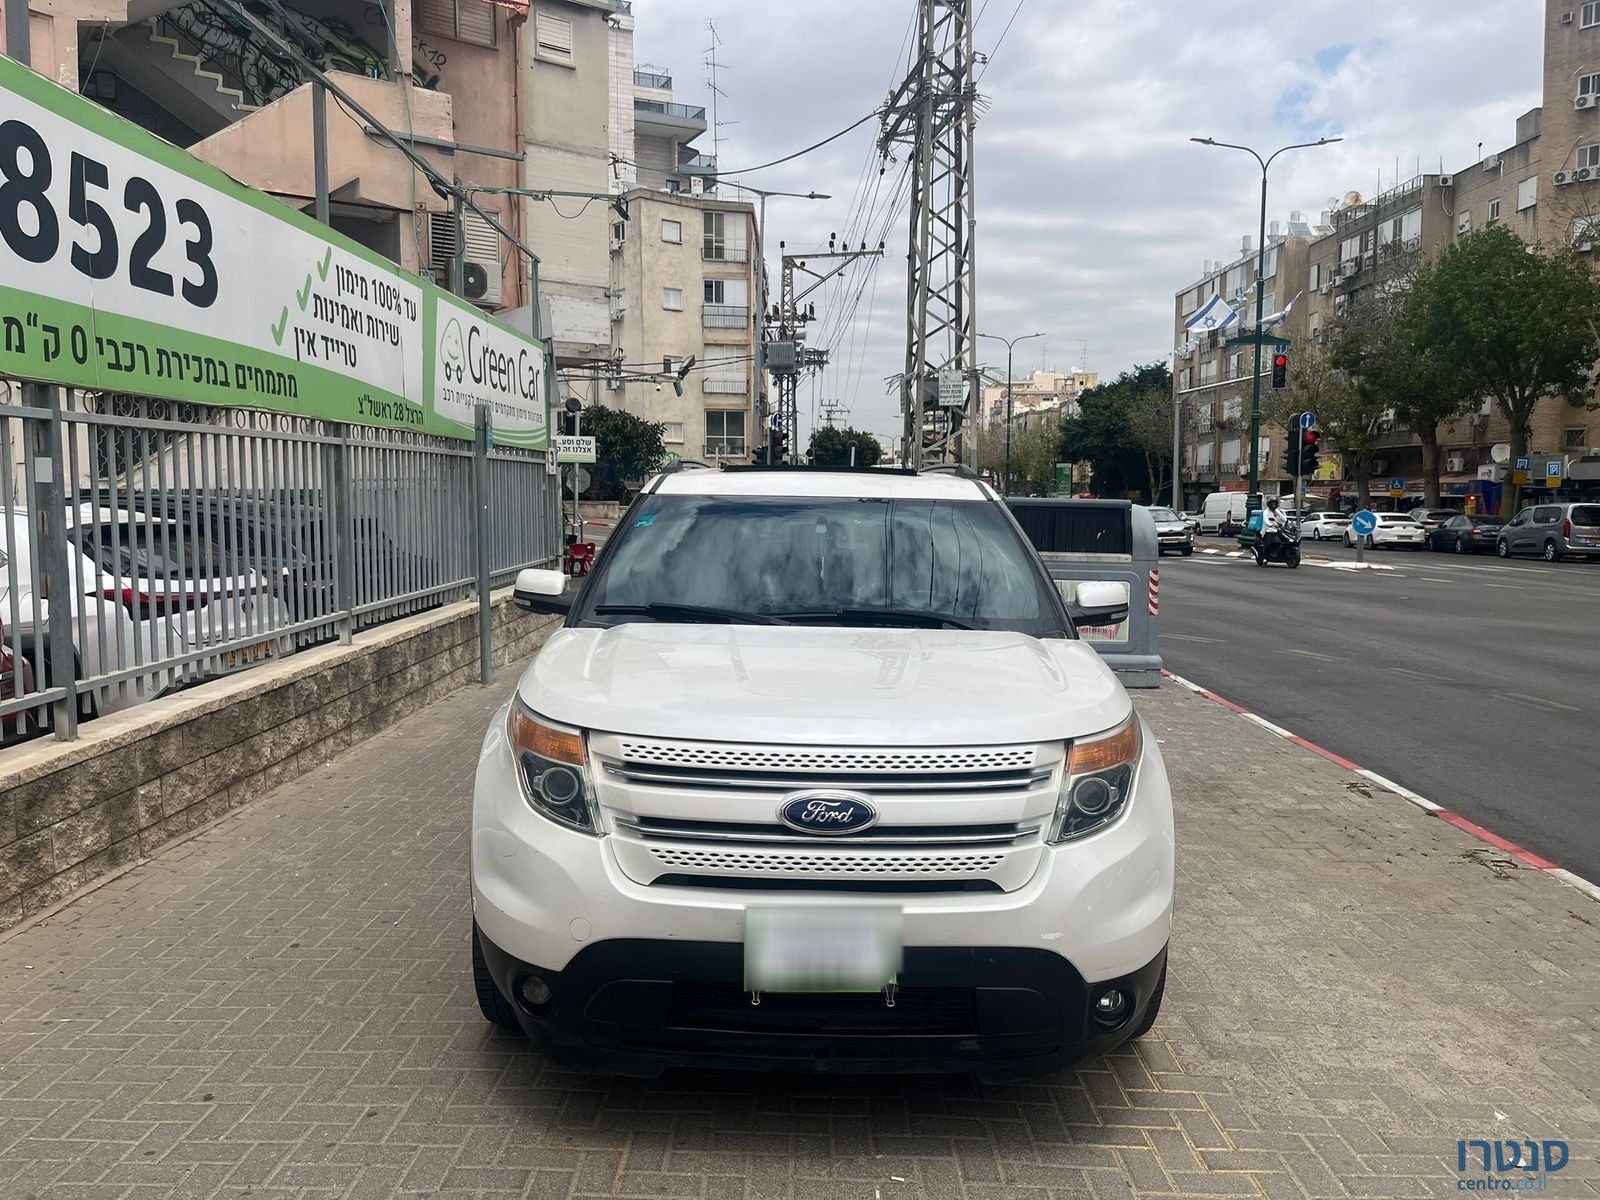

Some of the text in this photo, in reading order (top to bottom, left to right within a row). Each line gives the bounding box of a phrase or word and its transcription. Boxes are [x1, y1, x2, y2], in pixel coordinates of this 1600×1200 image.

[0, 119, 219, 308] 8523
[335, 264, 417, 322] עד 100% מימון
[313, 293, 400, 347] שירות ואמינות
[71, 324, 88, 365] 0
[95, 336, 151, 375] רכבי
[294, 326, 357, 368] טרייד אין
[468, 325, 540, 402] Green Car
[156, 347, 231, 388] במכירת
[235, 363, 298, 399] מתמחים
[393, 401, 404, 422] 28
[405, 403, 424, 426] הרצל
[572, 445, 592, 453] אצלנו
[575, 438, 592, 446] שלם
[801, 800, 855, 823] Ford
